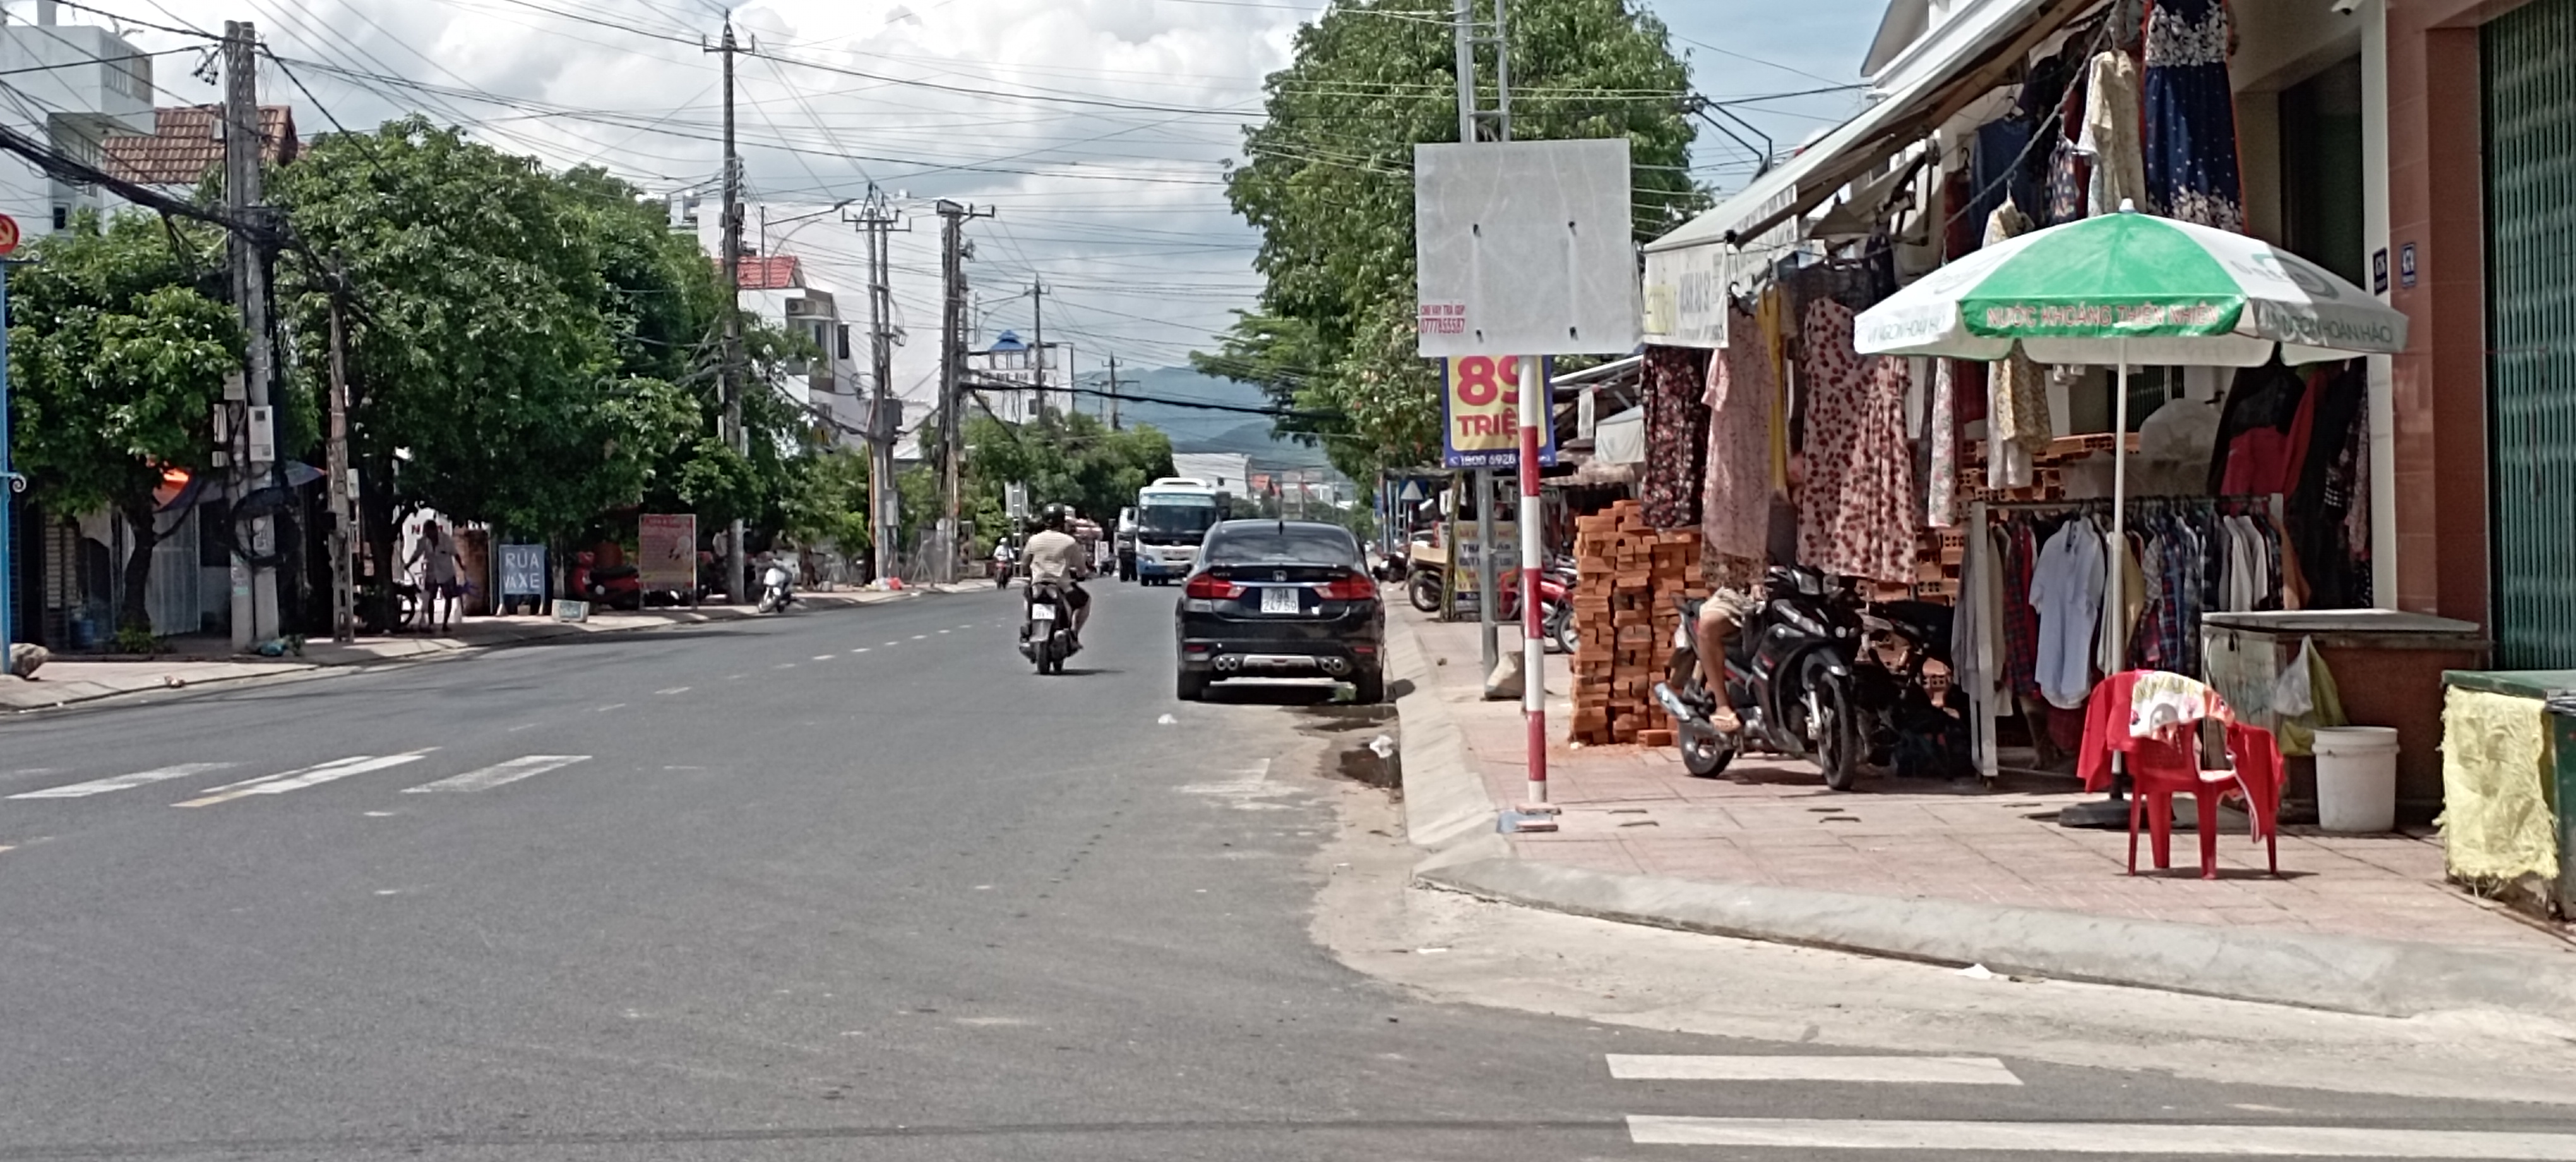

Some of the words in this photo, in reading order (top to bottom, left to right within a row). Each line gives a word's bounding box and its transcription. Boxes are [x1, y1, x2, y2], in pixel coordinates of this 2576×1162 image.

[2040, 300, 2112, 327] KHOÁNG
[2116, 300, 2165, 326] THIÊN
[2168, 300, 2220, 326] NHIÊN
[1456, 407, 1518, 440] TRIỆ
